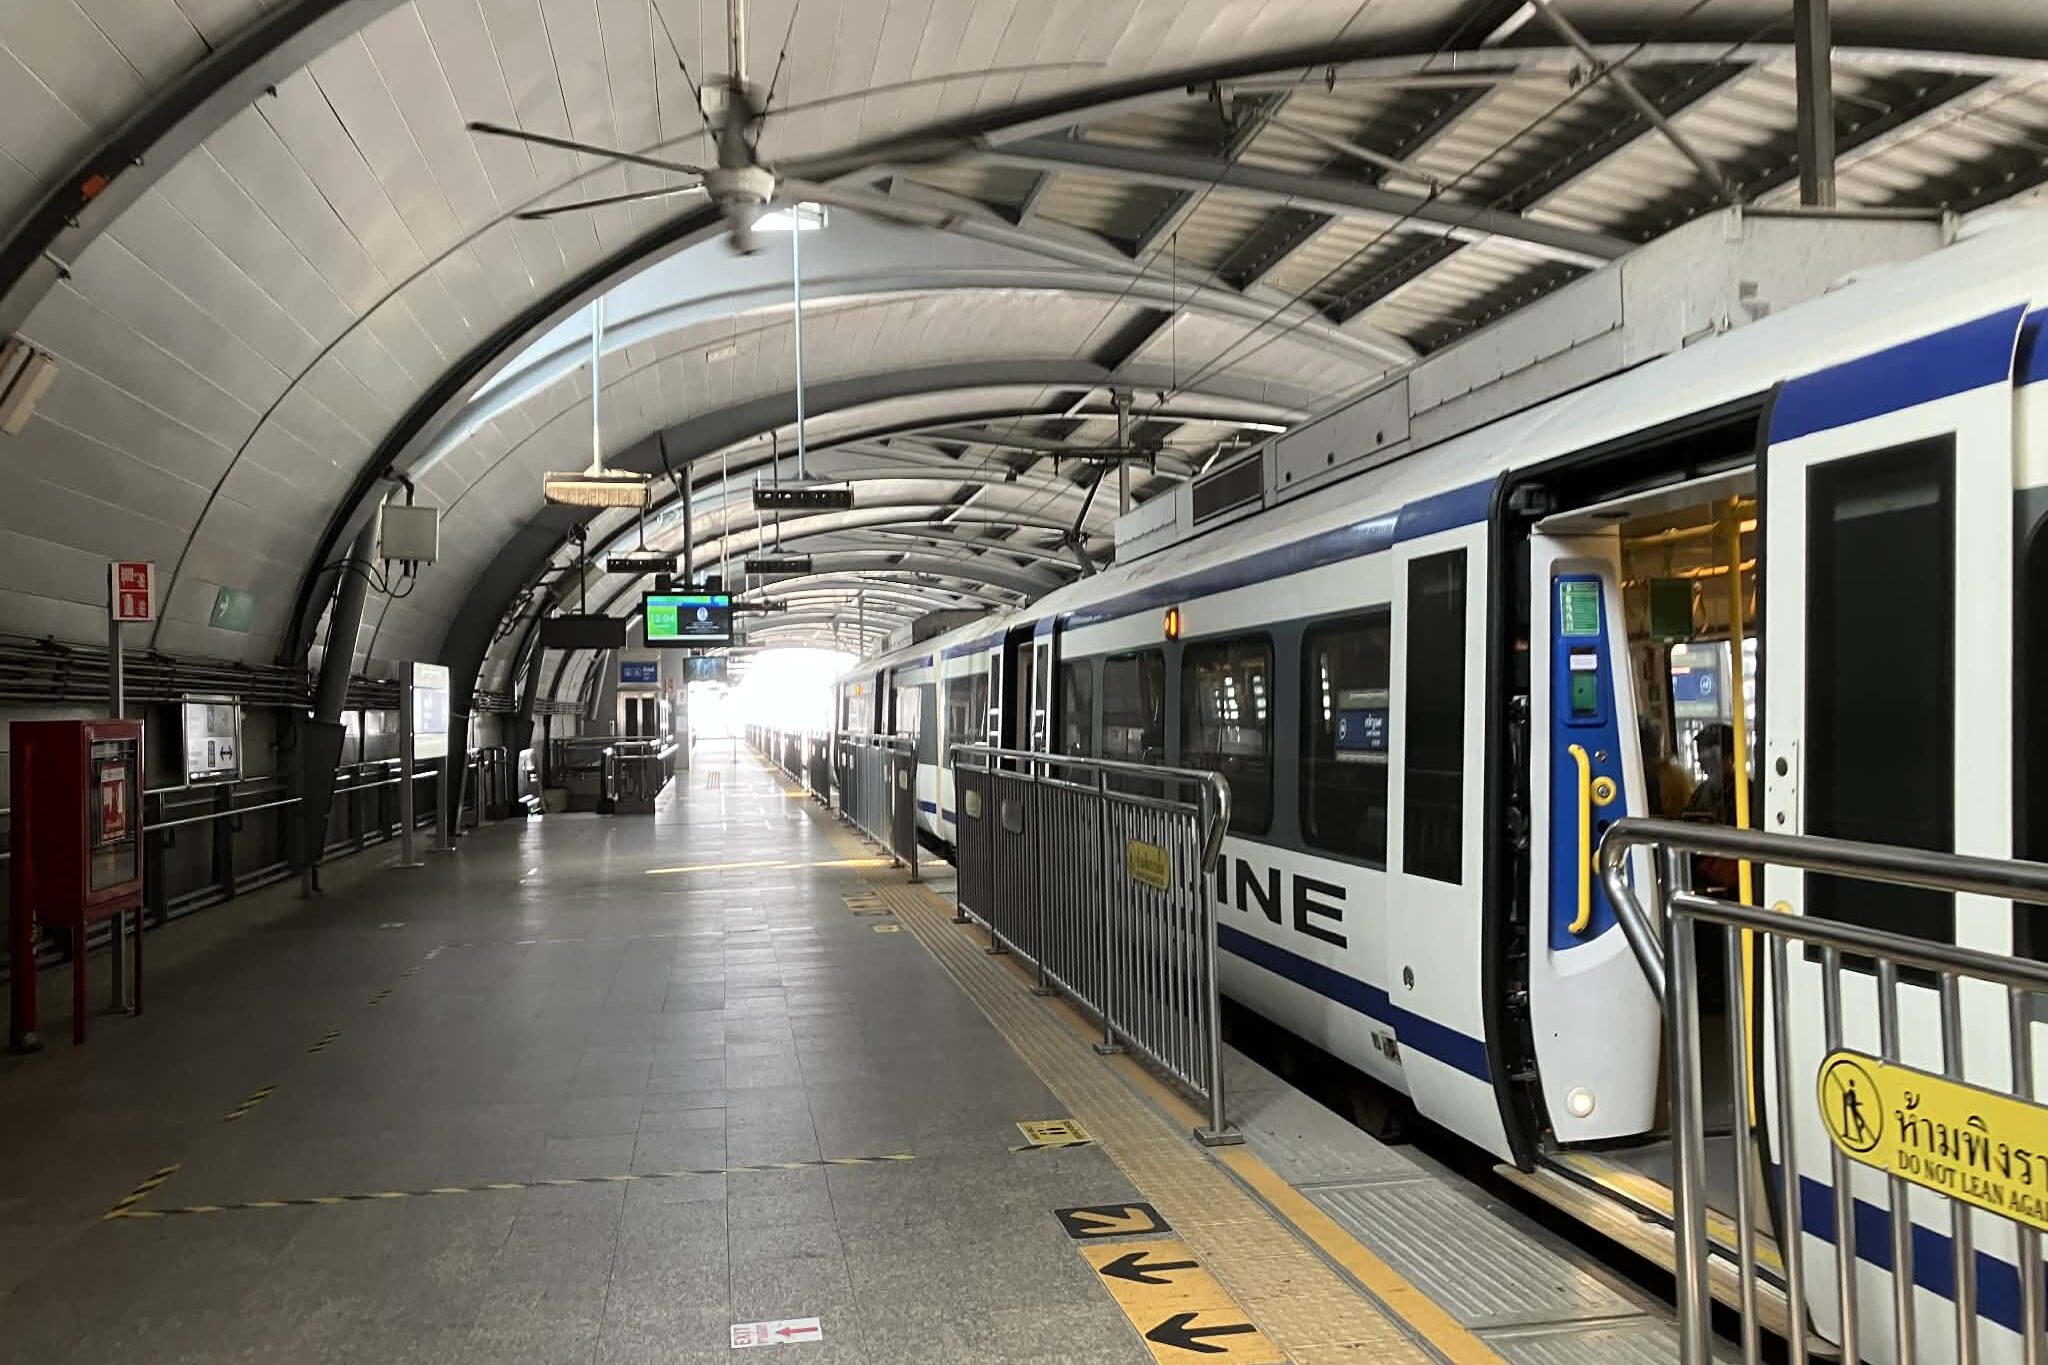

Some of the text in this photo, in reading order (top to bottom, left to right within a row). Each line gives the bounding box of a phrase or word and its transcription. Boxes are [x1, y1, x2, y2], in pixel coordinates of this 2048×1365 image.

[1898, 1149, 1920, 1175] DO
[1924, 1159, 1956, 1188] NOT
[1961, 1172, 2004, 1205] LEAN
